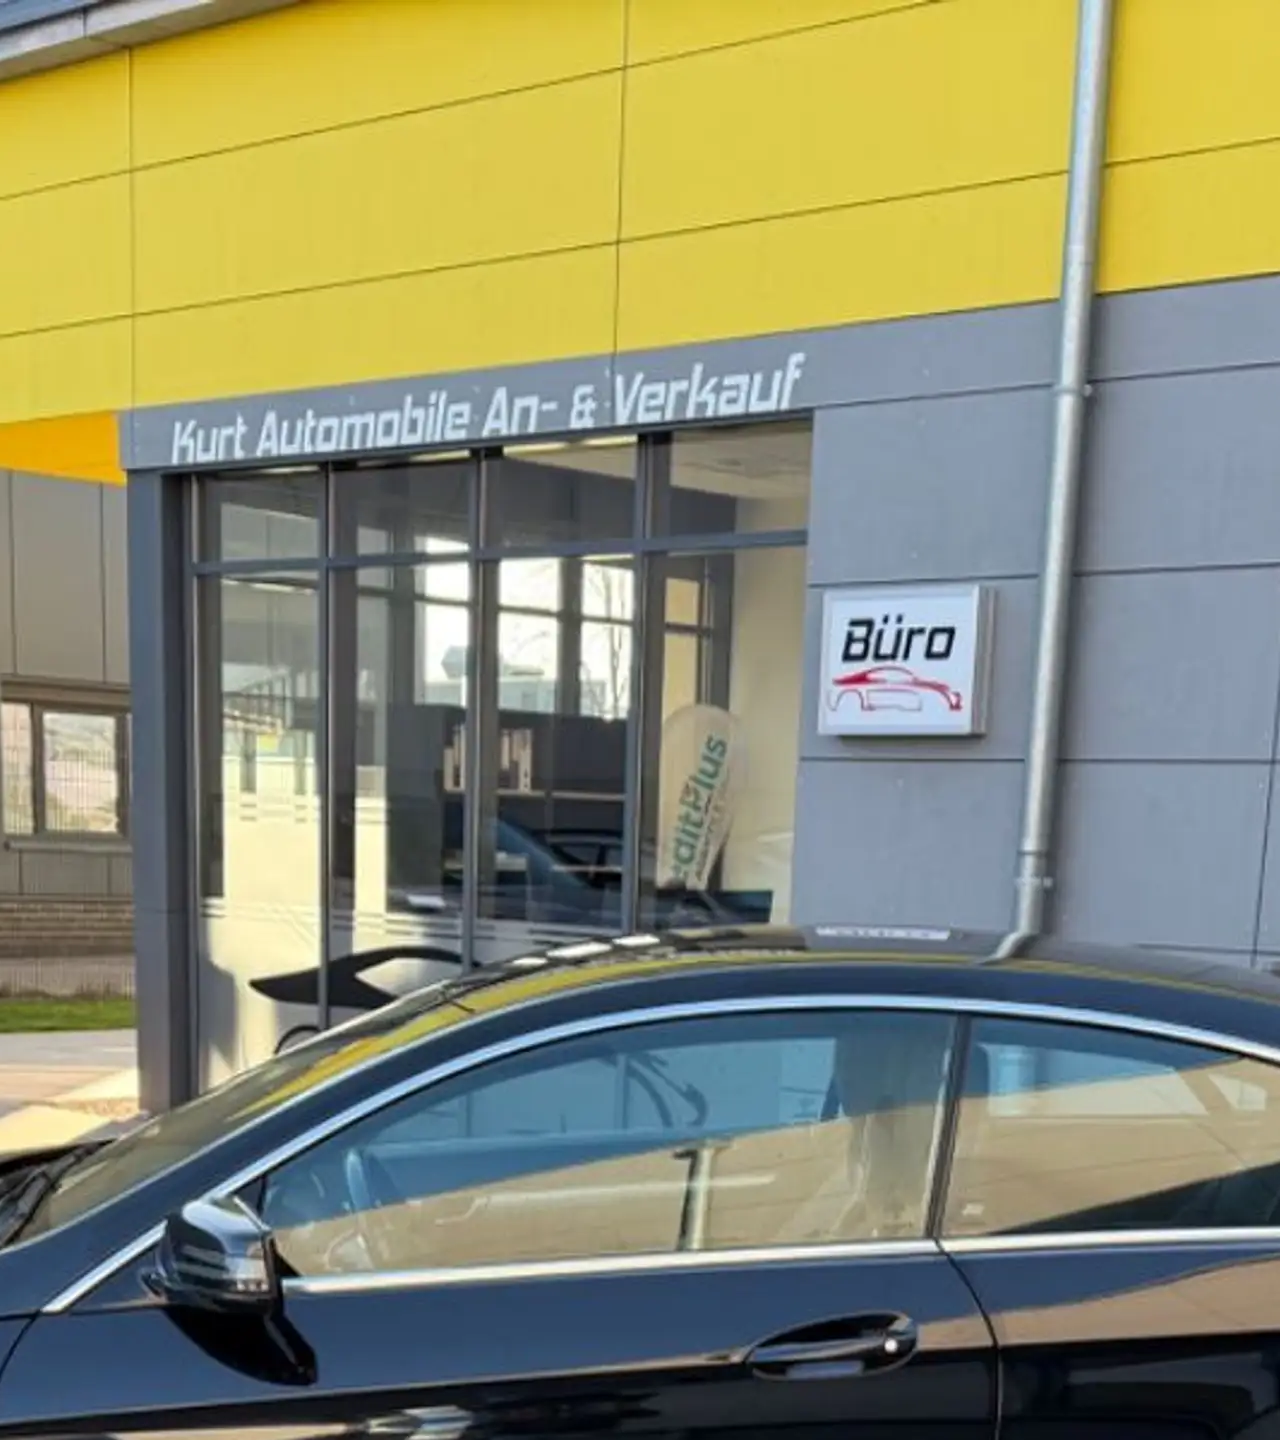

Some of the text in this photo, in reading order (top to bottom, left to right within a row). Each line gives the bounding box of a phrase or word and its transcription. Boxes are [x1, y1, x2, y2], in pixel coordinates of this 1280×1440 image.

[172, 352, 805, 464] Kurt Automobile An- & Verkauf
[841, 613, 956, 662] Büro
